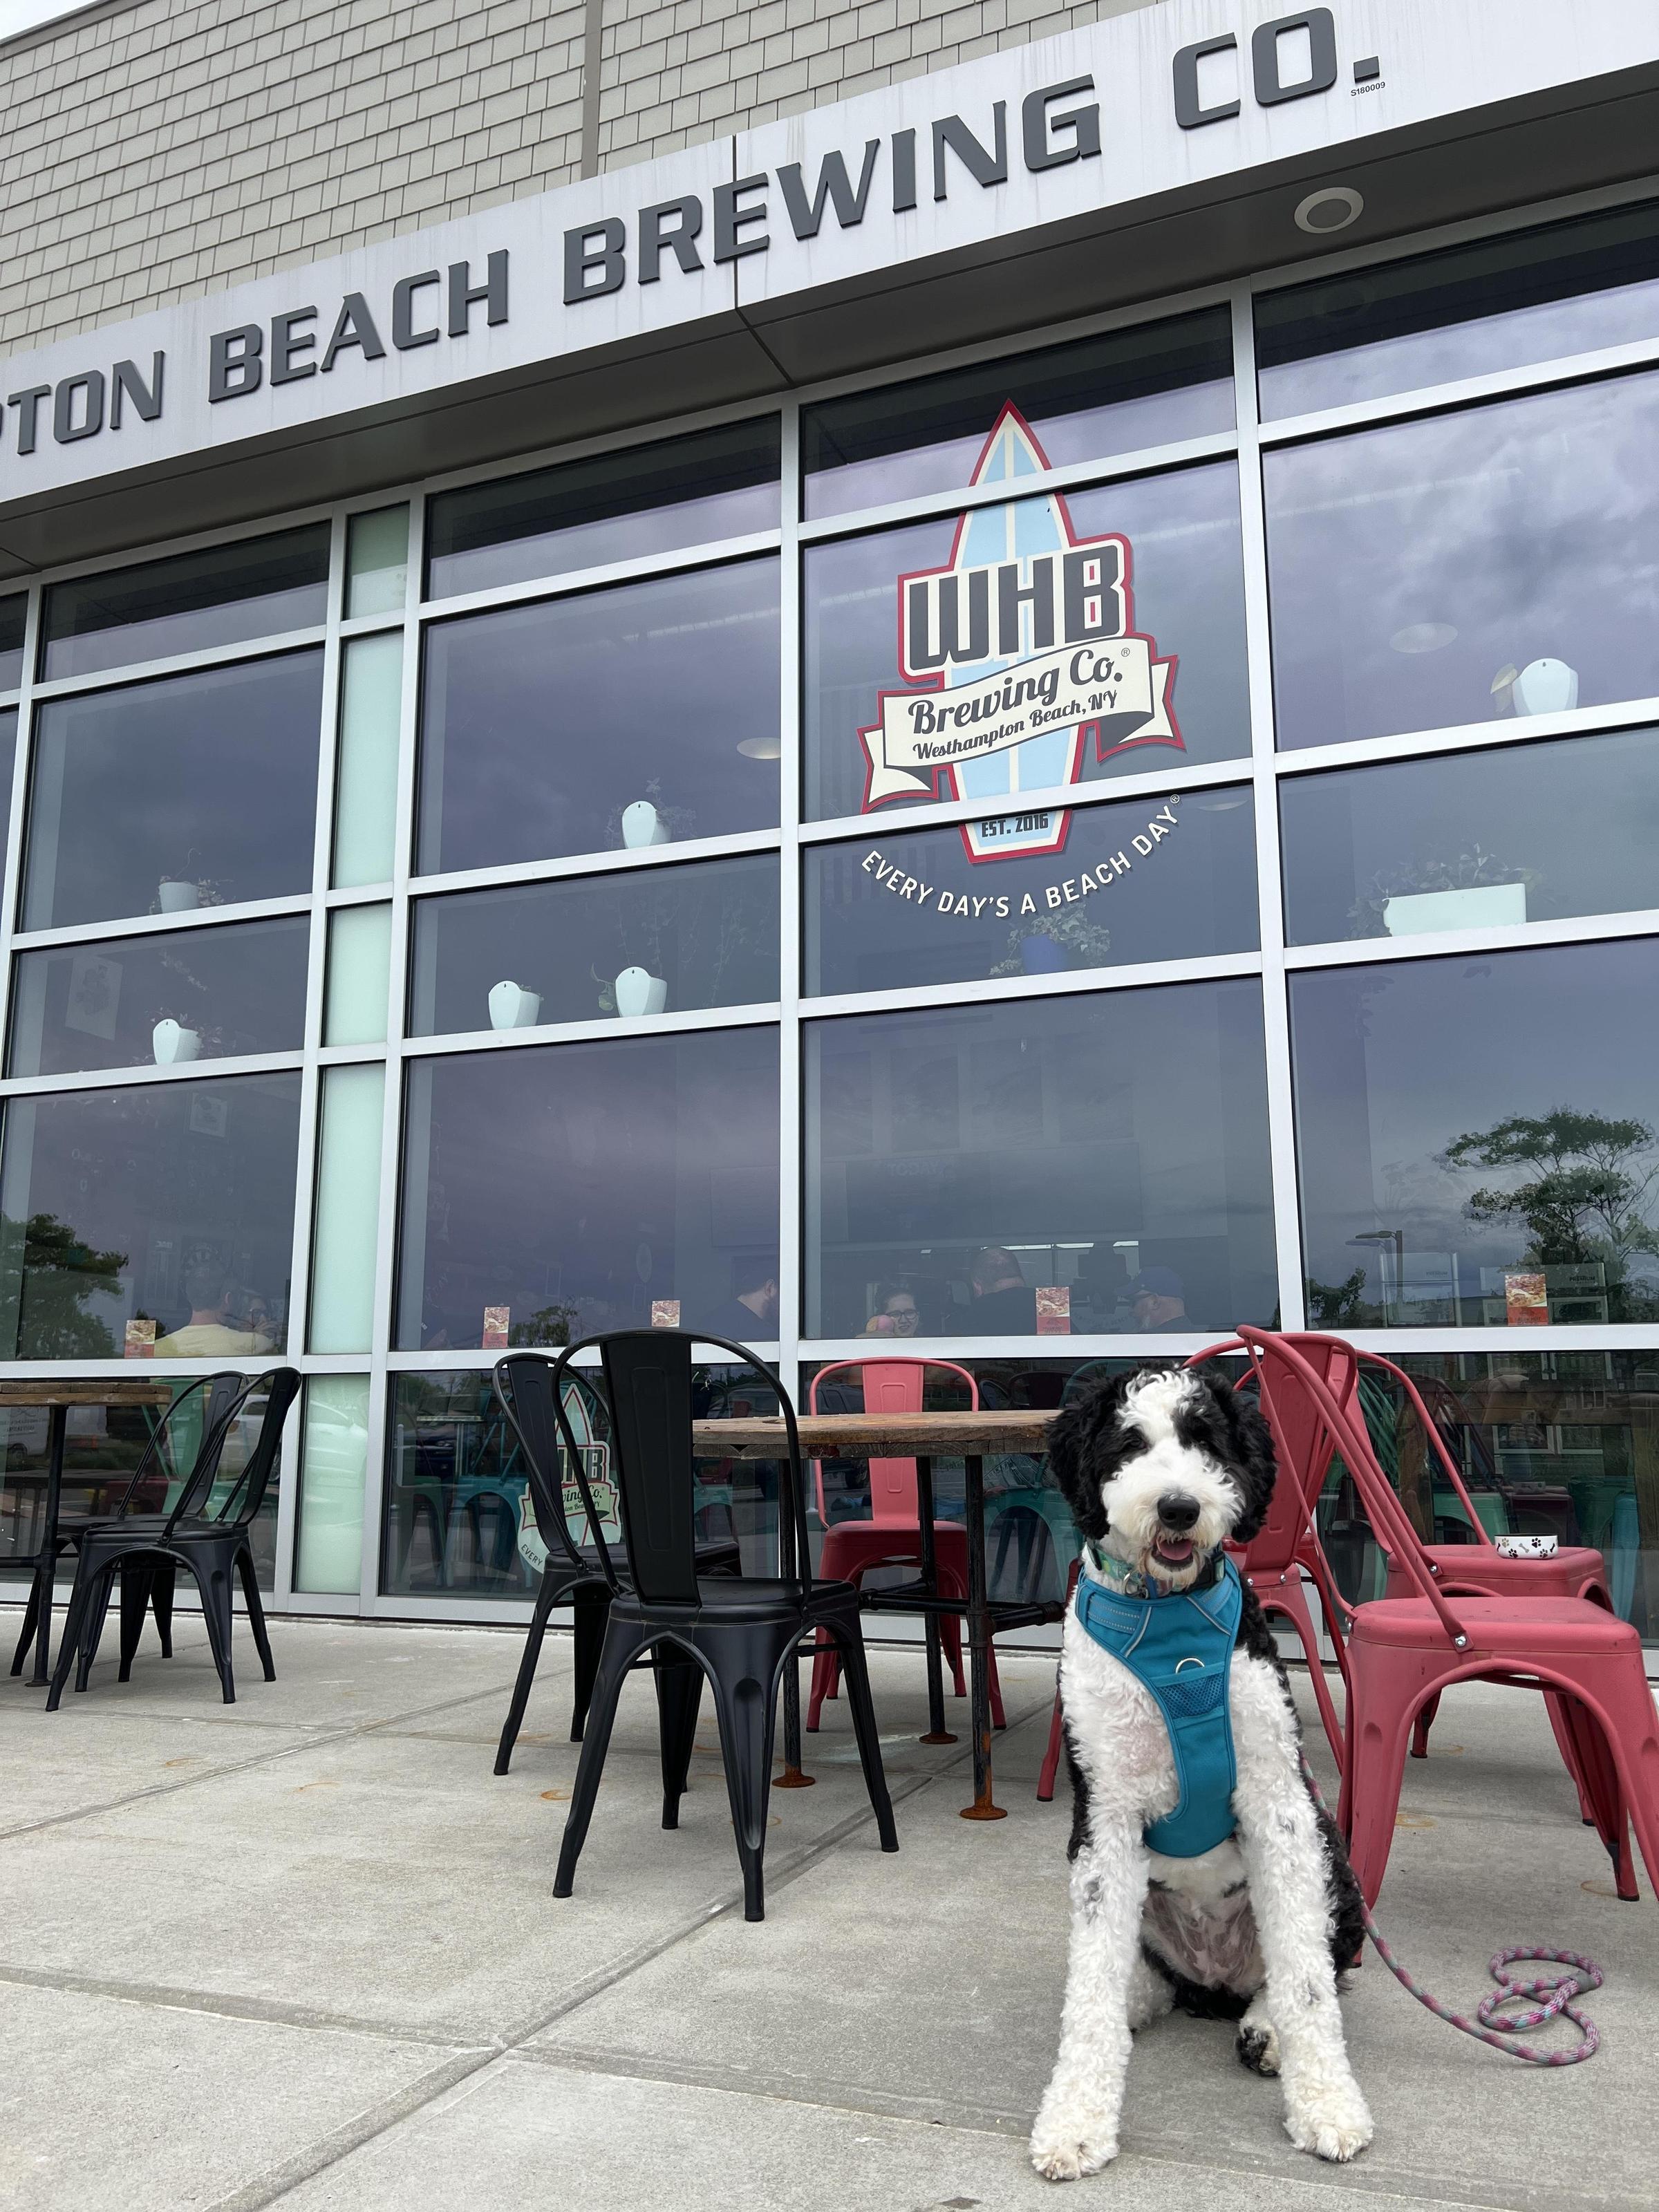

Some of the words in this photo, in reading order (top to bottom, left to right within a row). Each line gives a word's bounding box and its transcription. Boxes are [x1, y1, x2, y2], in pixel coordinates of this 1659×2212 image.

[1351, 82, 1385, 96] S180009
[0, 350, 165, 456] TON
[209, 248, 509, 404] BEACH
[563, 73, 1103, 306] BREWING
[1173, 7, 1380, 129] CO.
[909, 545, 1119, 671] WHB
[908, 668, 1060, 734] Brewing
[1070, 649, 1123, 685] Co.
[913, 720, 1024, 759] Westhampton
[1029, 699, 1086, 727] Beach,
[1088, 690, 1117, 710] NY
[861, 850, 933, 906] EVERY
[937, 891, 1009, 917] DAY'S
[1020, 893, 1036, 915] A
[1046, 851, 1132, 908] BEACH
[1132, 805, 1179, 856] DAY
[982, 820, 1011, 837] EST.
[1015, 814, 1049, 832] 2016
[521, 1544, 543, 1566] EVERY
